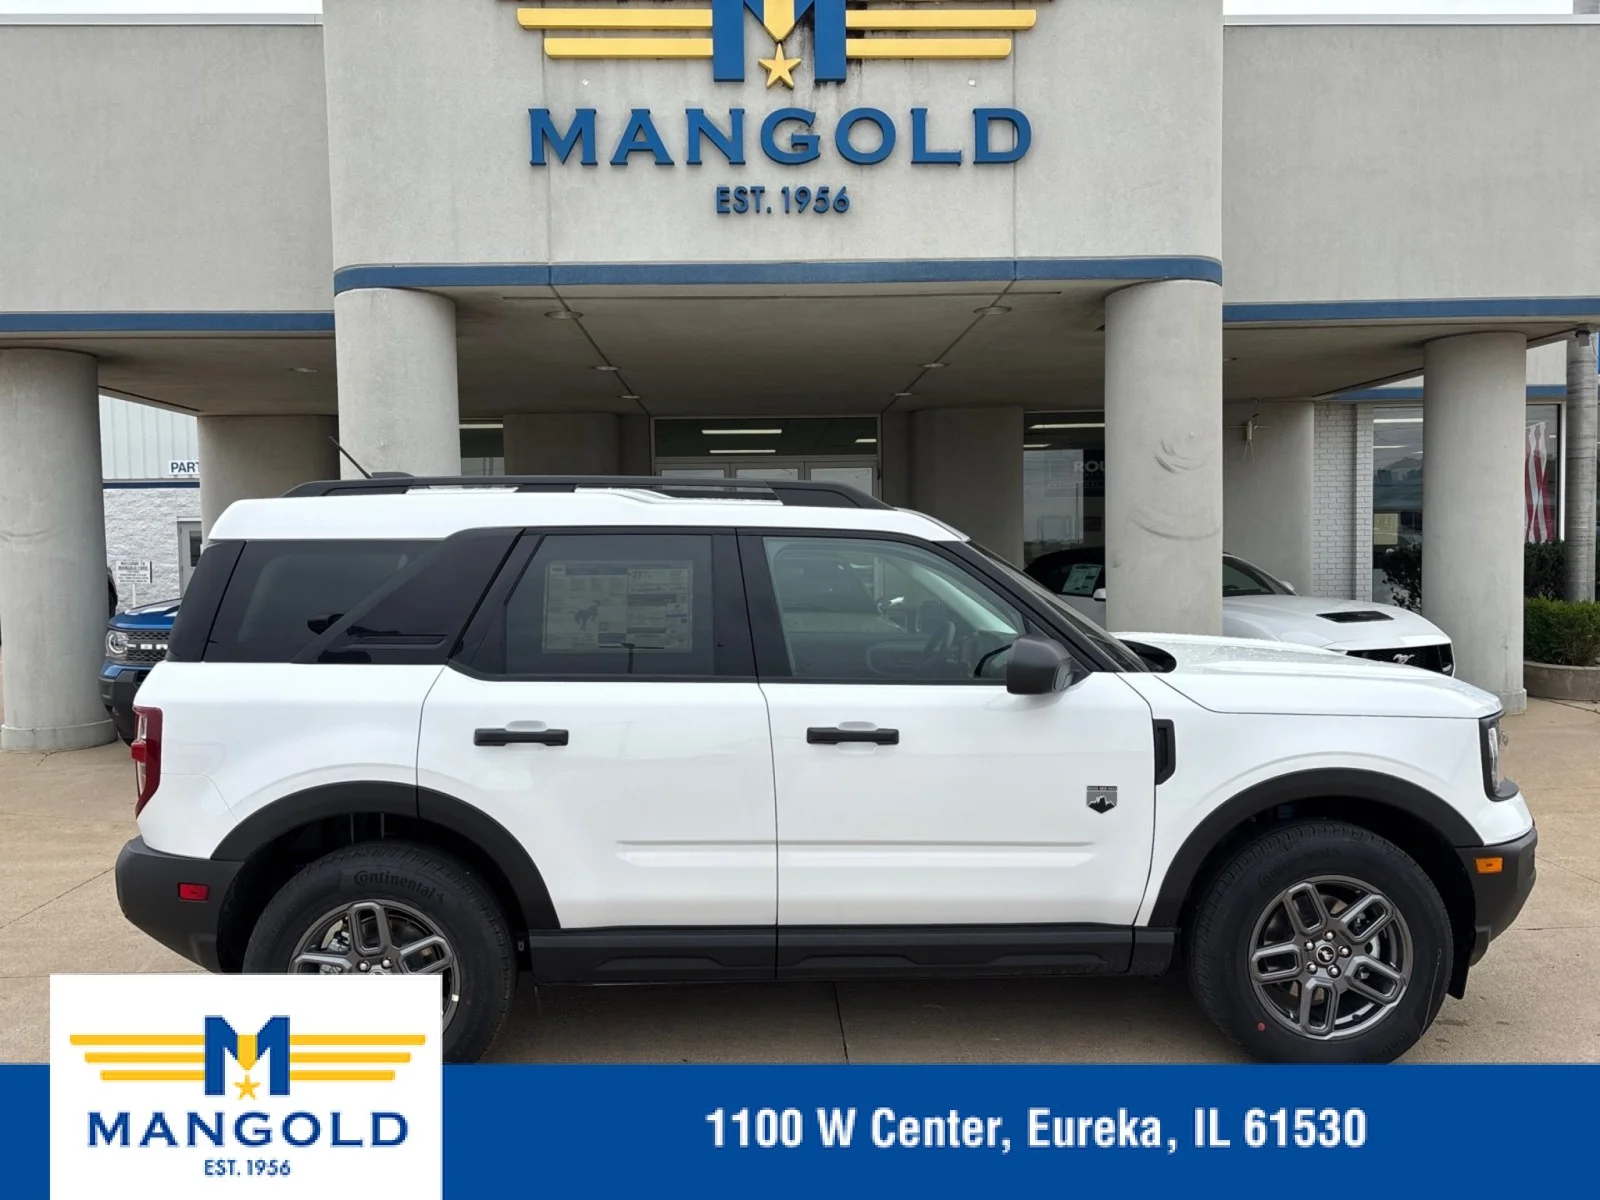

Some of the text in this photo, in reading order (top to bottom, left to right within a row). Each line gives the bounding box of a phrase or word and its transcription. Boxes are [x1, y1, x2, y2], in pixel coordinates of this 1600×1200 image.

[528, 107, 1032, 166] MANGOLD
[715, 185, 850, 214] EST. 1956
[353, 870, 437, 899] Continental
